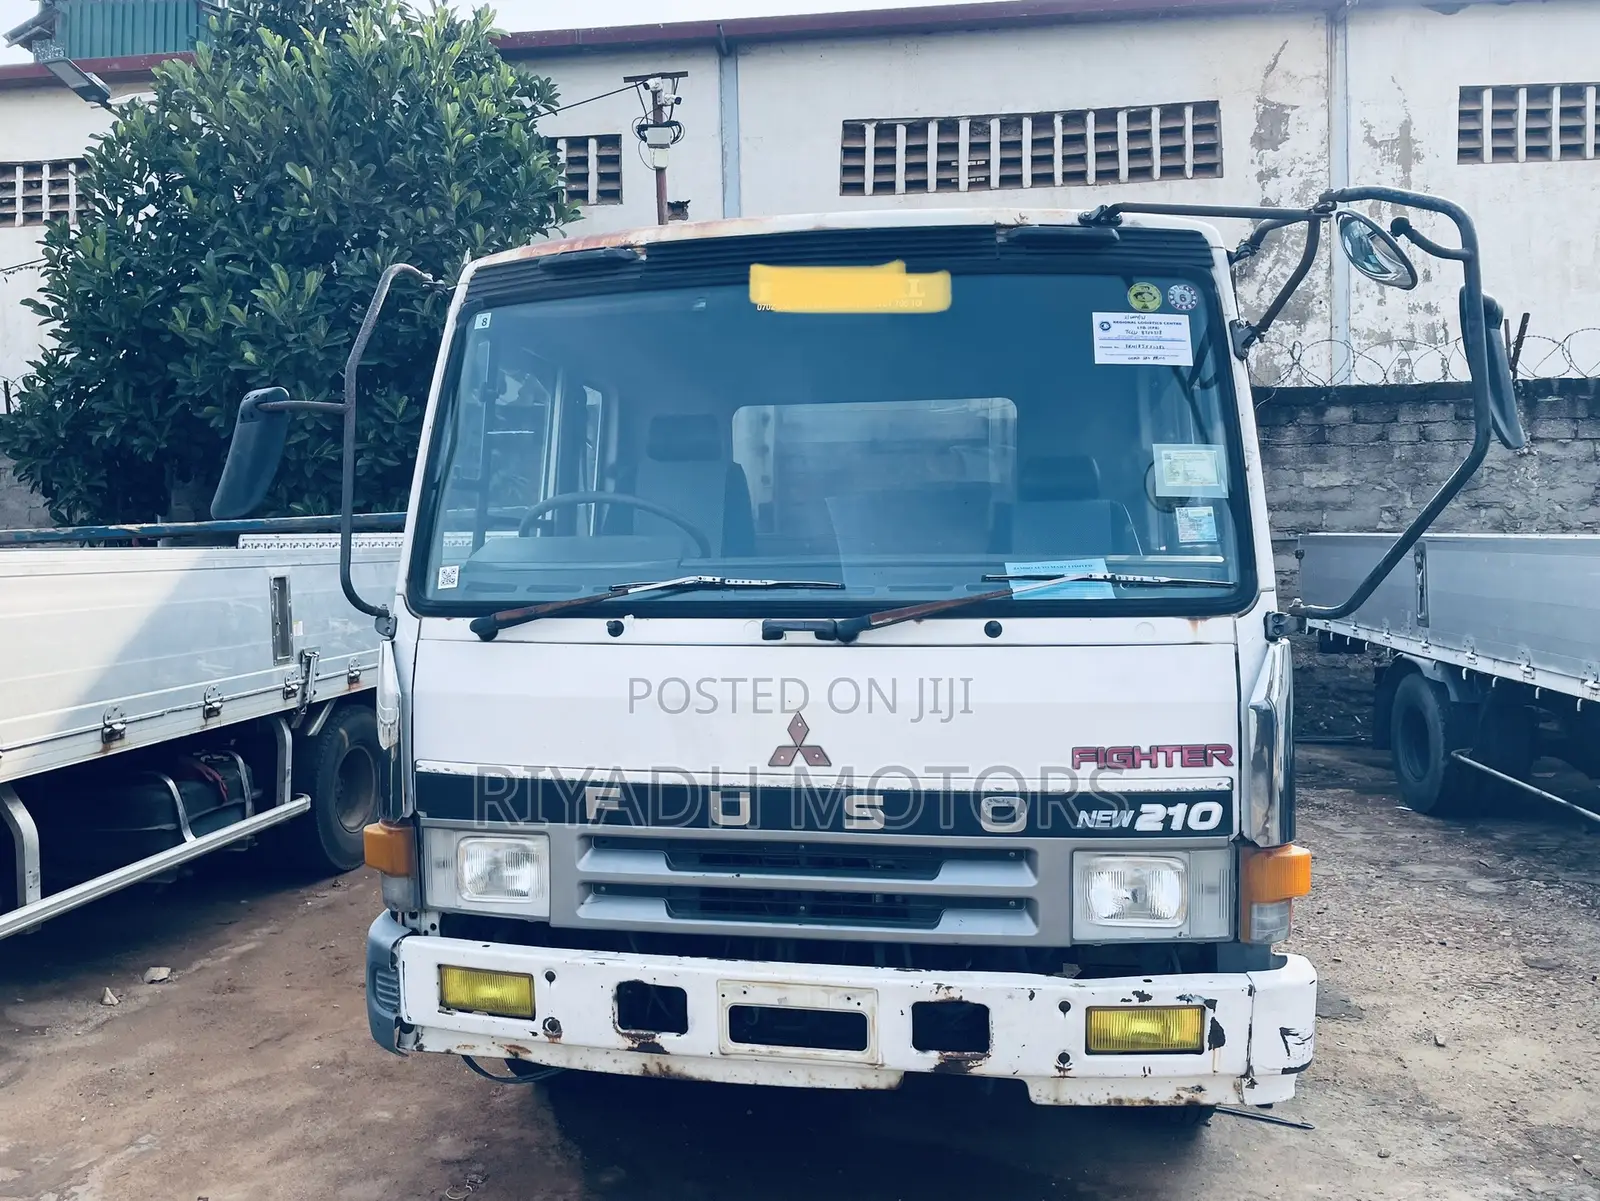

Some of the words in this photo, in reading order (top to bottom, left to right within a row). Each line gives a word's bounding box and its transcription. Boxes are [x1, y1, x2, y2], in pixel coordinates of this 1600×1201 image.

[1179, 293, 1187, 302] 6
[481, 317, 488, 327] 8
[1072, 743, 1234, 770] FIGHTER
[585, 786, 1027, 833] FUSO
[1076, 810, 1134, 829] NEW
[1134, 801, 1224, 832] 210
